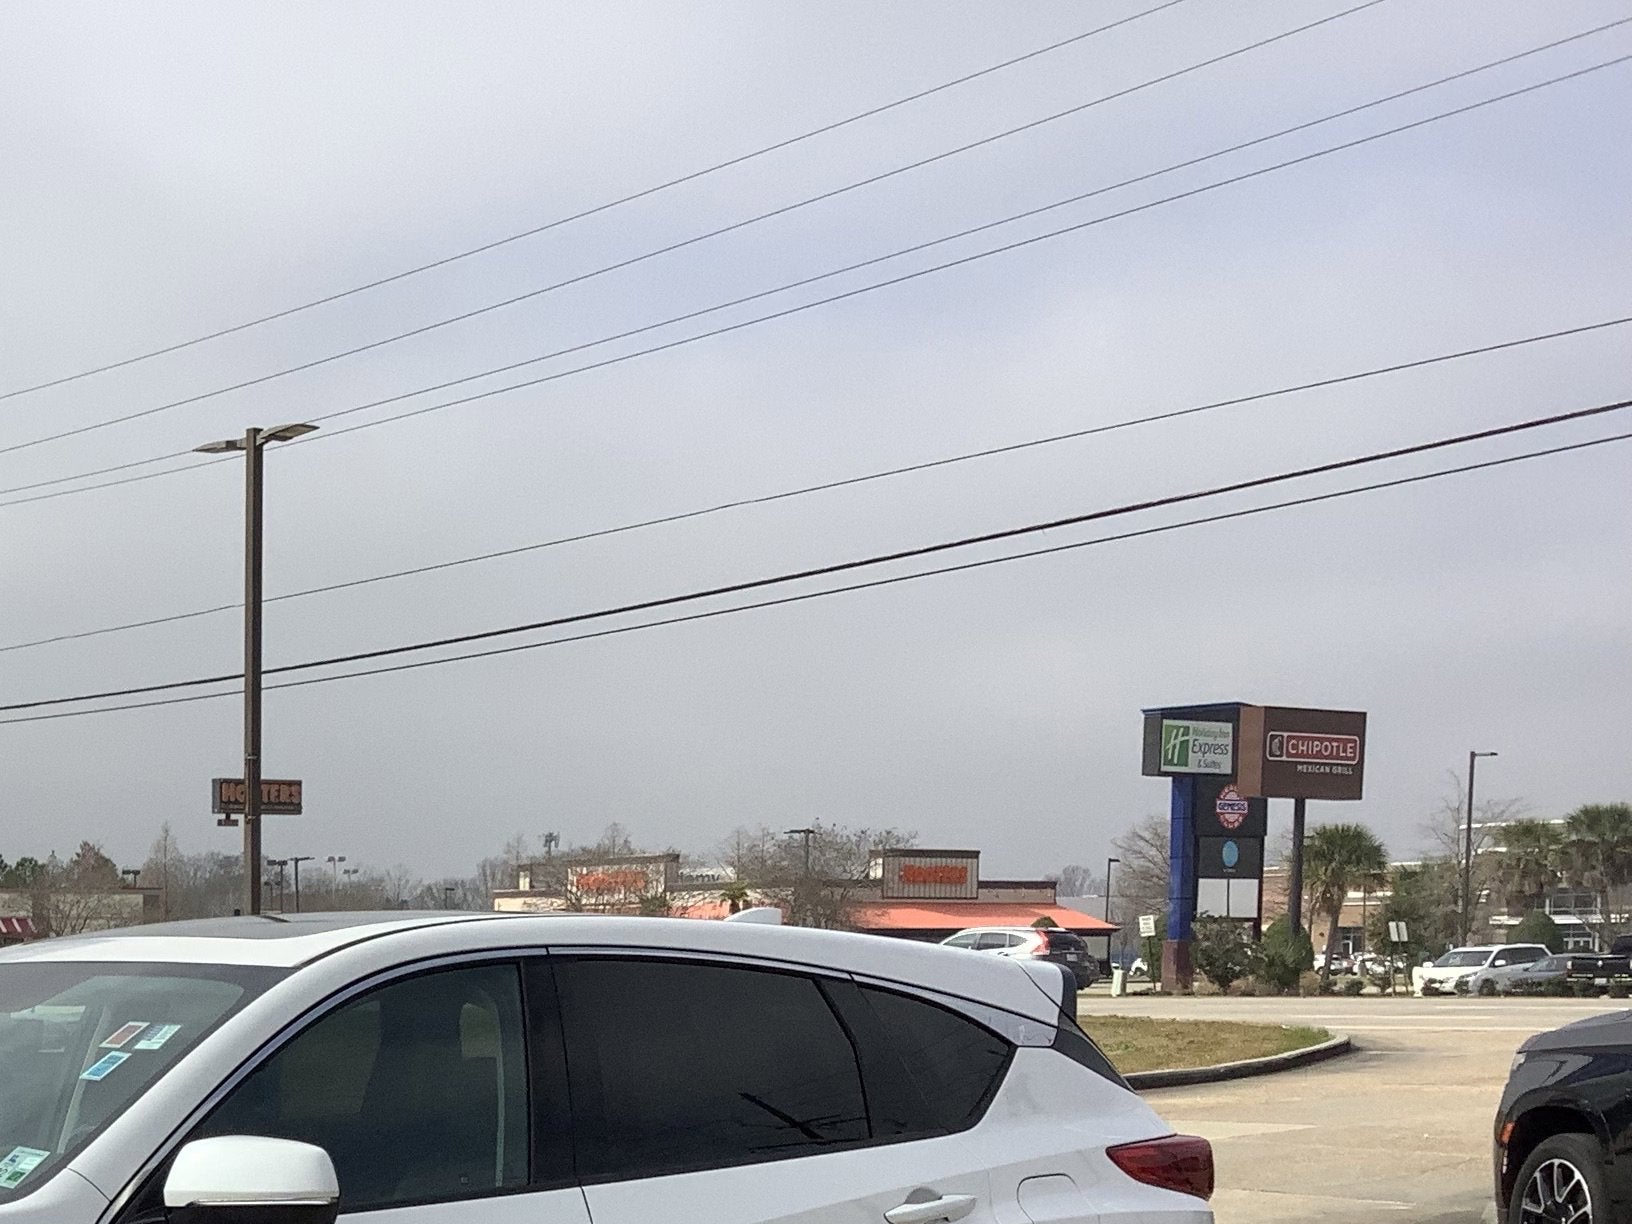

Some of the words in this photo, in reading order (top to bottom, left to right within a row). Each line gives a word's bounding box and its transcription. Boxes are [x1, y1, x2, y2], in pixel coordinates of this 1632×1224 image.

[1192, 739, 1229, 757] Express
[1288, 740, 1355, 757] CHIPOTLE
[1297, 765, 1330, 773] MEXICAN
[1331, 766, 1353, 775] GRILL
[221, 783, 301, 803] HOTERS
